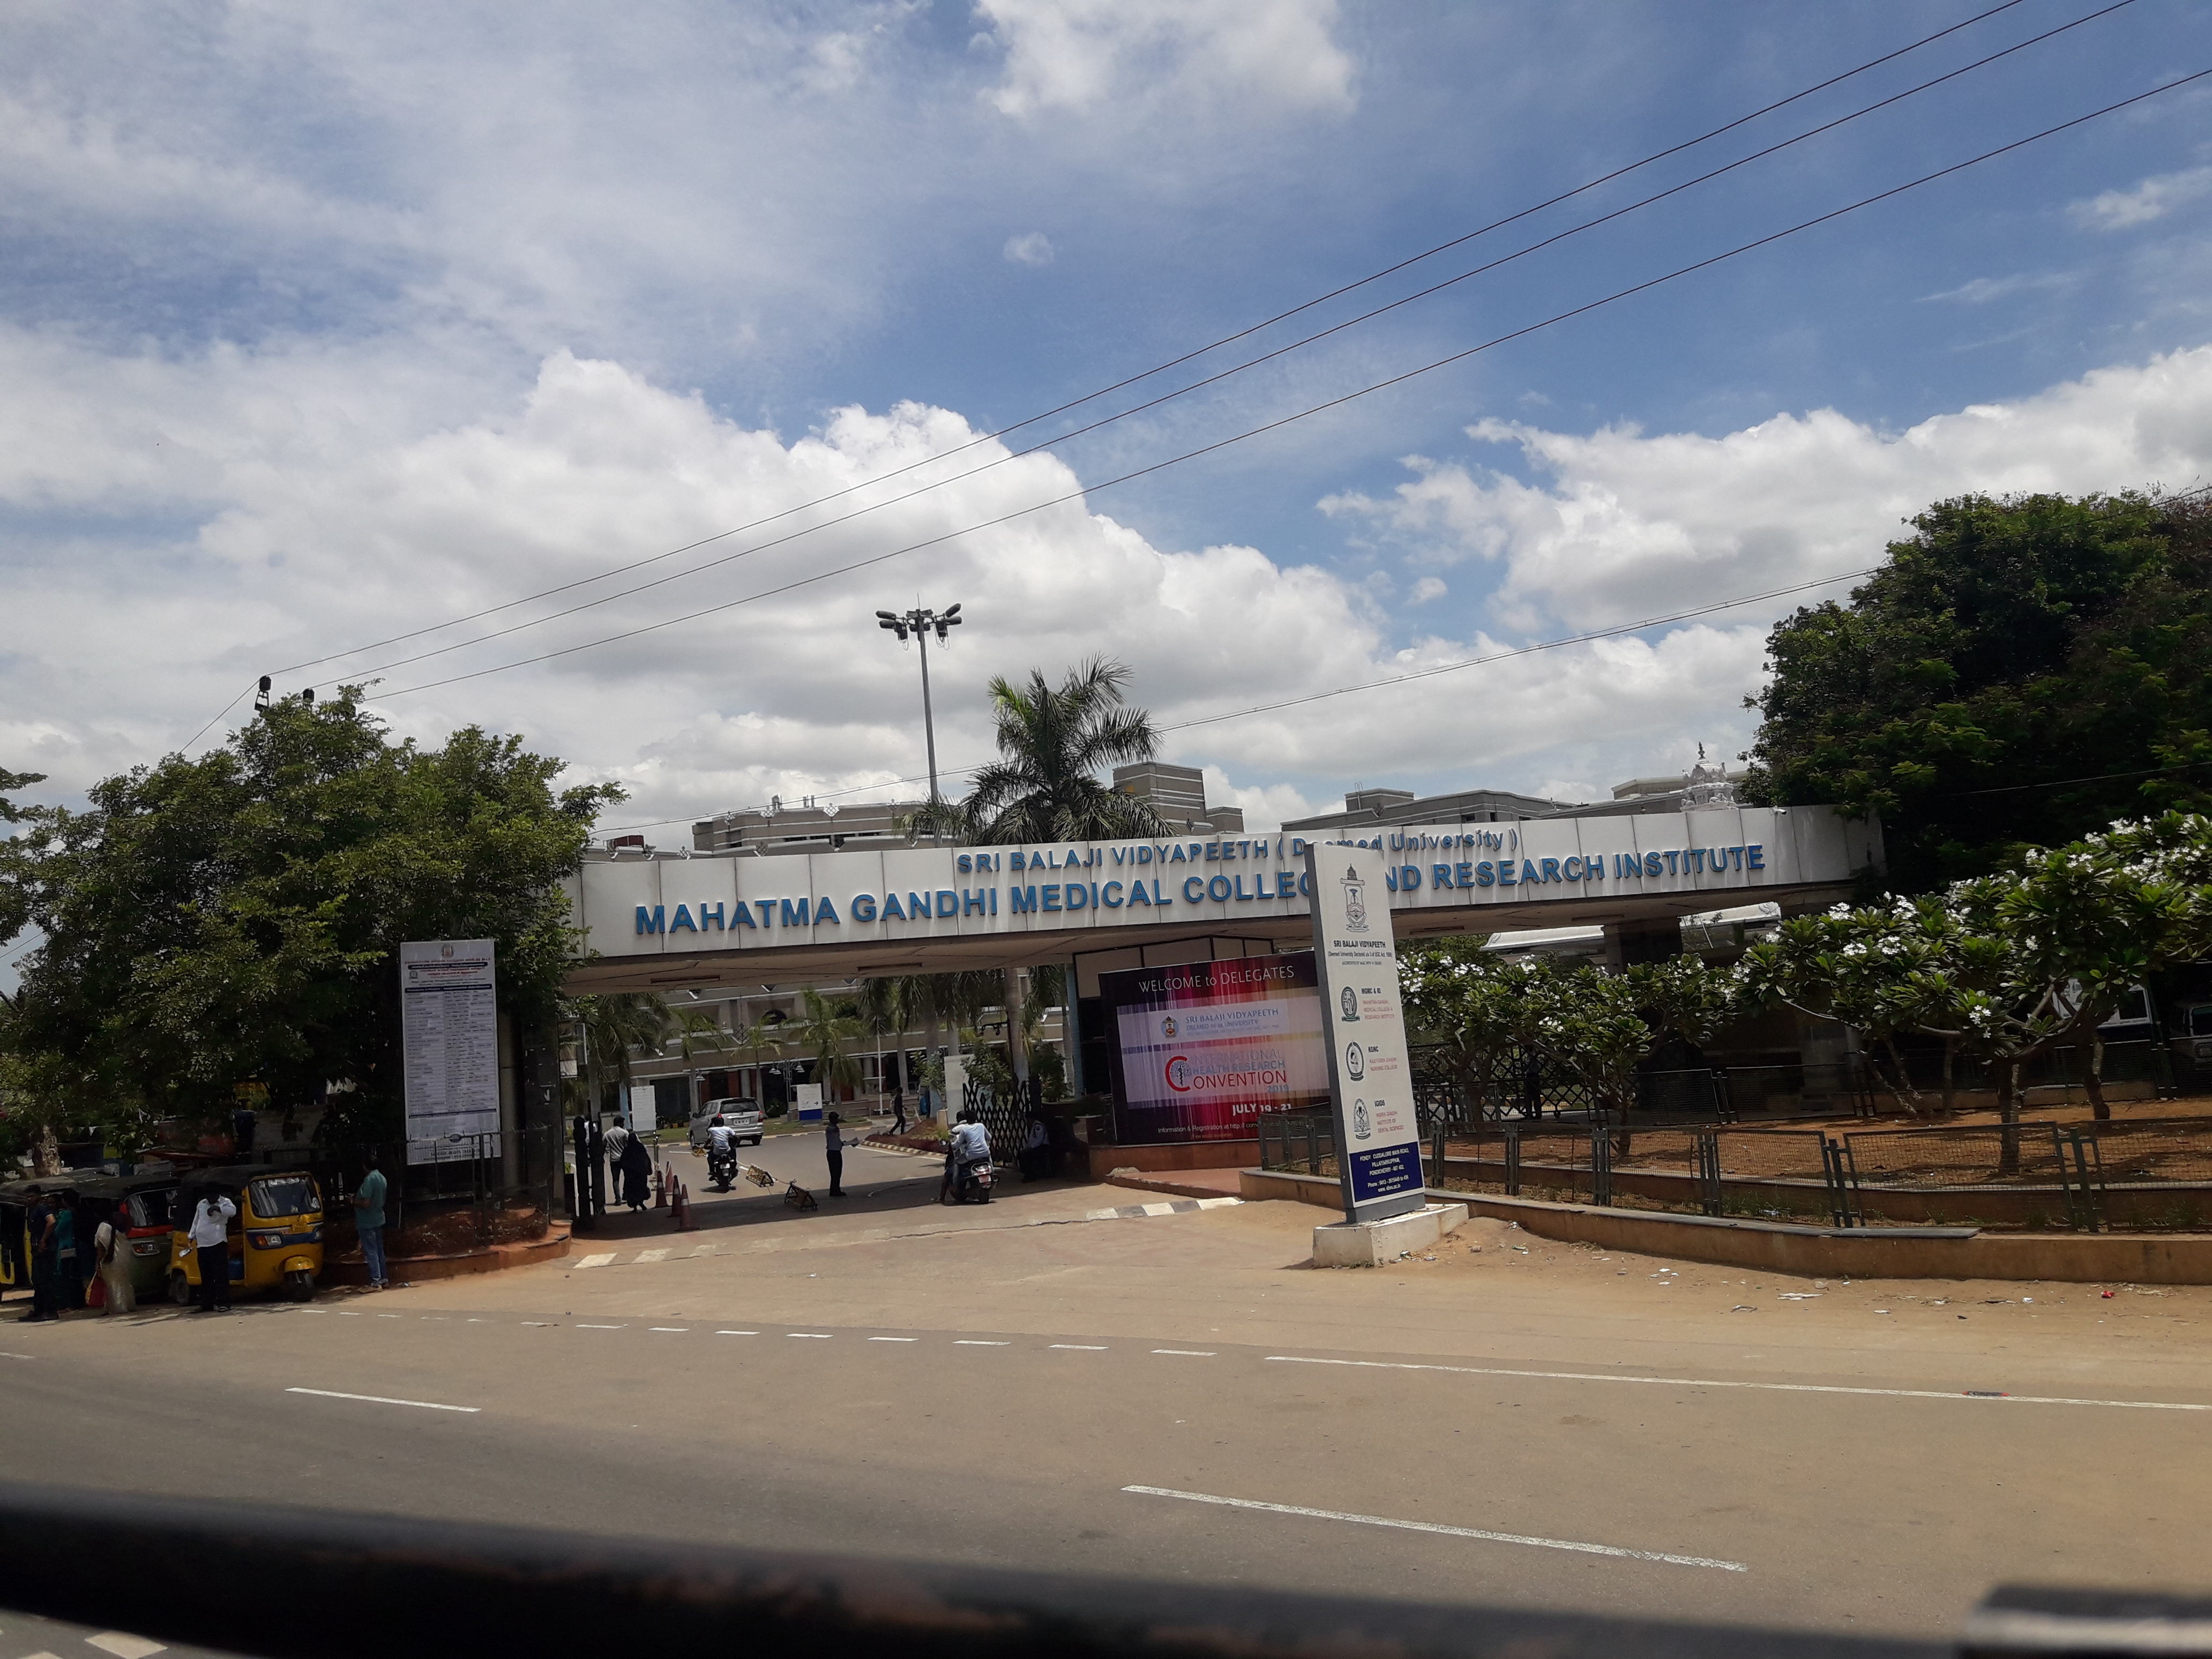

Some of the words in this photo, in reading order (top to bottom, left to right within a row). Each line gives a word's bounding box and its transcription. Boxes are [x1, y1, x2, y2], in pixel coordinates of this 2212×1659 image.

[958, 853, 1000, 873] SRI
[1010, 848, 1102, 871] BALAJI
[1111, 839, 1268, 865] VIDYAPEETH
[1389, 829, 1504, 851] University
[636, 896, 840, 934] MAHATMA
[851, 887, 998, 922] GANDHI
[1011, 878, 1172, 914] MEDICAL
[1183, 871, 1311, 903] COLLE
[1385, 865, 1422, 891] ND
[1432, 854, 1605, 890] RESEARCH
[1613, 845, 1766, 879] INSTITUTE
[1342, 940, 1359, 948] BALAJI
[1359, 940, 1386, 948] VIDYAPEETH
[1138, 975, 1201, 993] WELCOME
[1206, 976, 1217, 987] to
[1221, 965, 1295, 985] DELEGATES
[1186, 1016, 1198, 1024] SRI
[1200, 1013, 1225, 1022] BALAJI
[1227, 1008, 1279, 1020] VIDYAPEETH
[1225, 1019, 1258, 1027] UNIVERSITY
[1191, 1049, 1283, 1065] INTERNATIONAL
[1165, 1055, 1287, 1092] CONVENTION
[1194, 1064, 1230, 1075] HEALTH
[1232, 1060, 1286, 1071] RESEARCH
[1267, 1085, 1289, 1093] 2019
[1232, 1103, 1257, 1116] JULY
[1193, 1124, 1223, 1132] Registration
